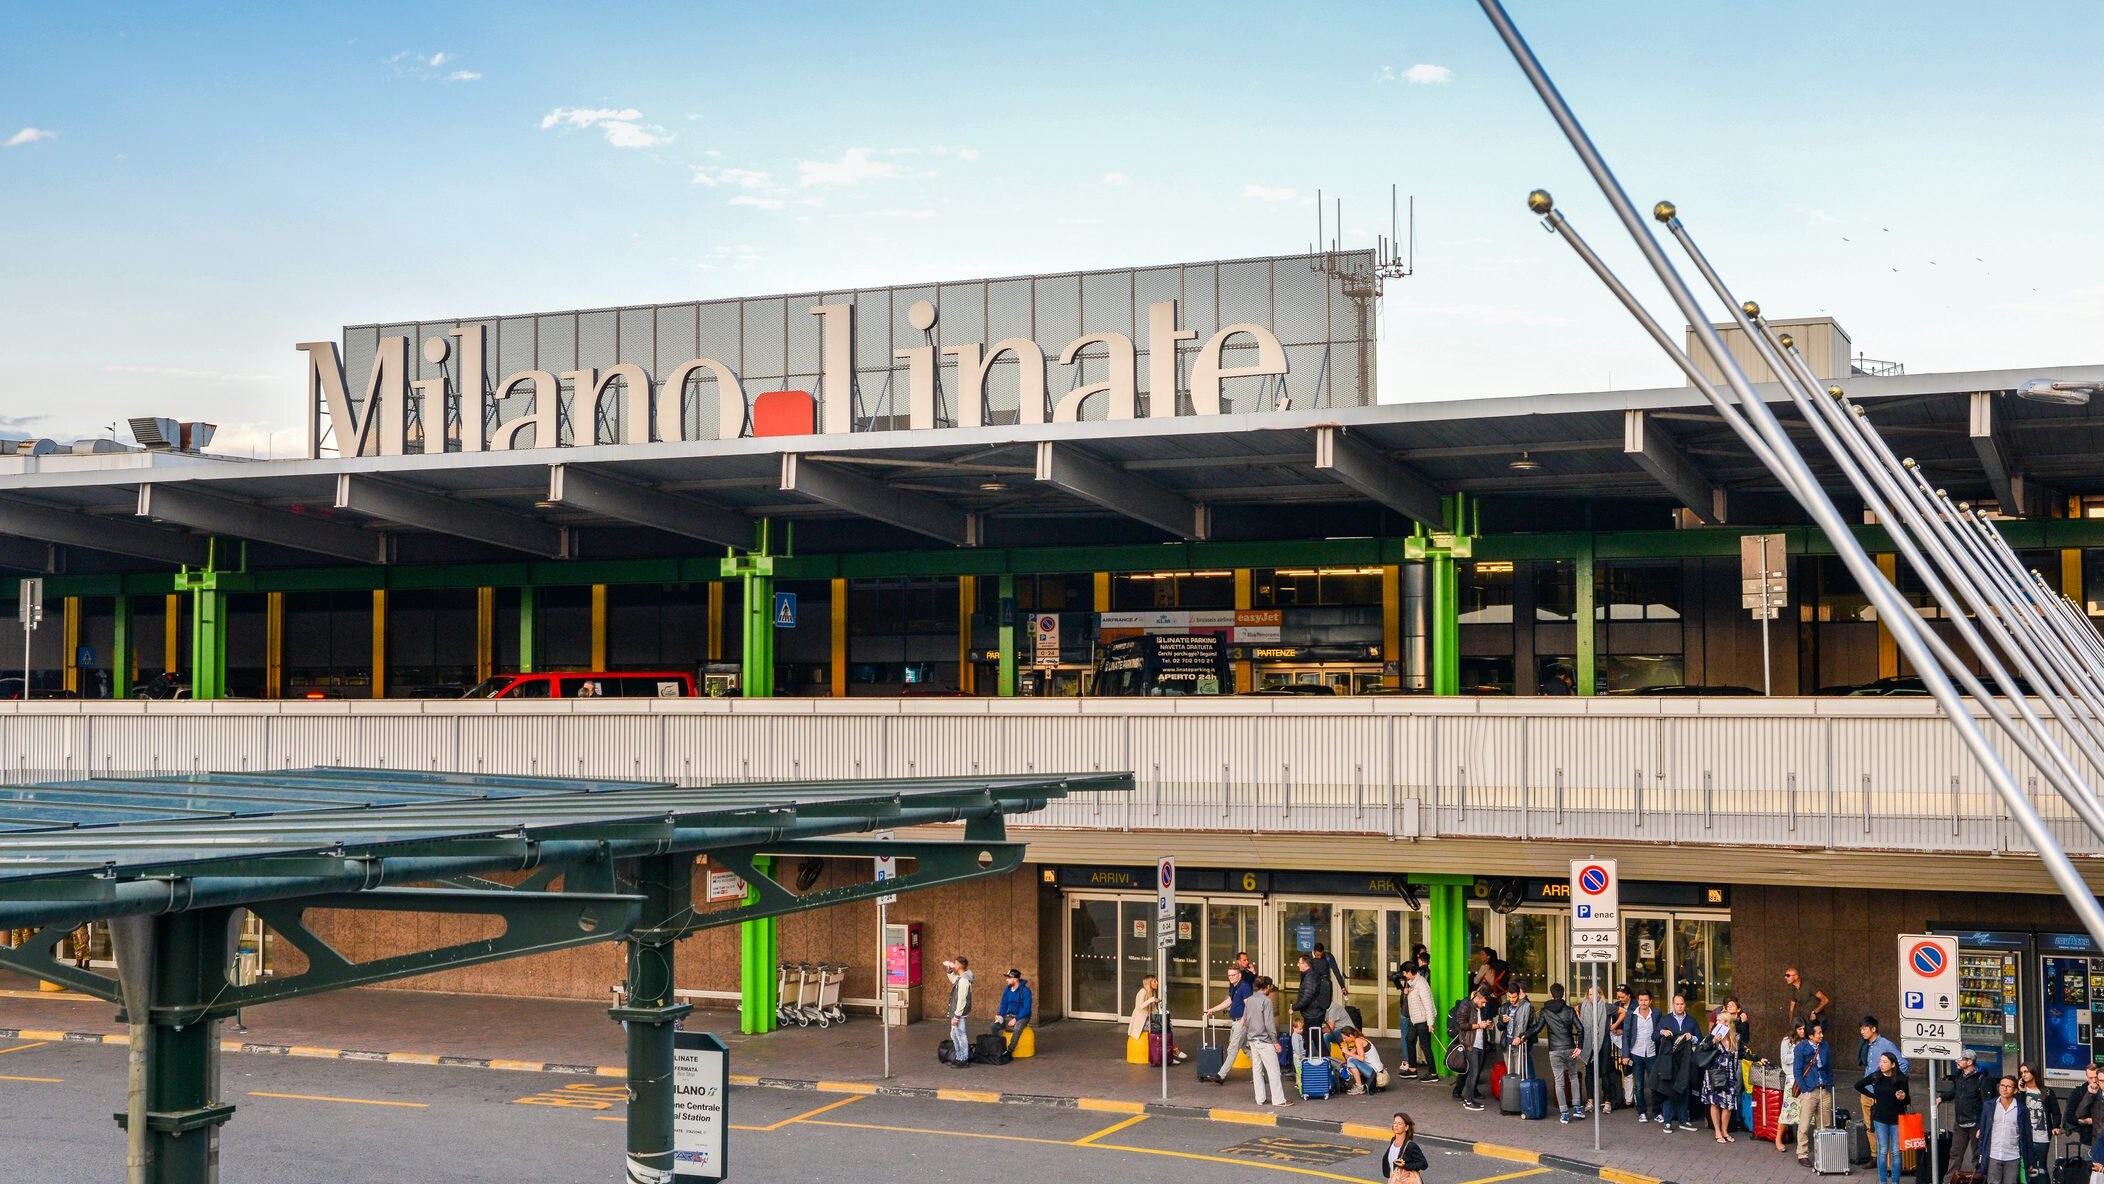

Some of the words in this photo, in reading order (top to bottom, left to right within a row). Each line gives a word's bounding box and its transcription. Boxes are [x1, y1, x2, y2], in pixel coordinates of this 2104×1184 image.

[295, 324, 748, 459] Milano
[1238, 612, 1279, 624] easyJet
[1234, 648, 1242, 659] 3
[1255, 649, 1296, 657] PARTENZE
[1091, 872, 1130, 884] ARRIVI
[1242, 872, 1257, 891] 6
[1474, 879, 1489, 898] 6
[1916, 1023, 1945, 1038] 0-24
[687, 1102, 721, 1112] Centrale
[682, 1113, 711, 1122] Station
